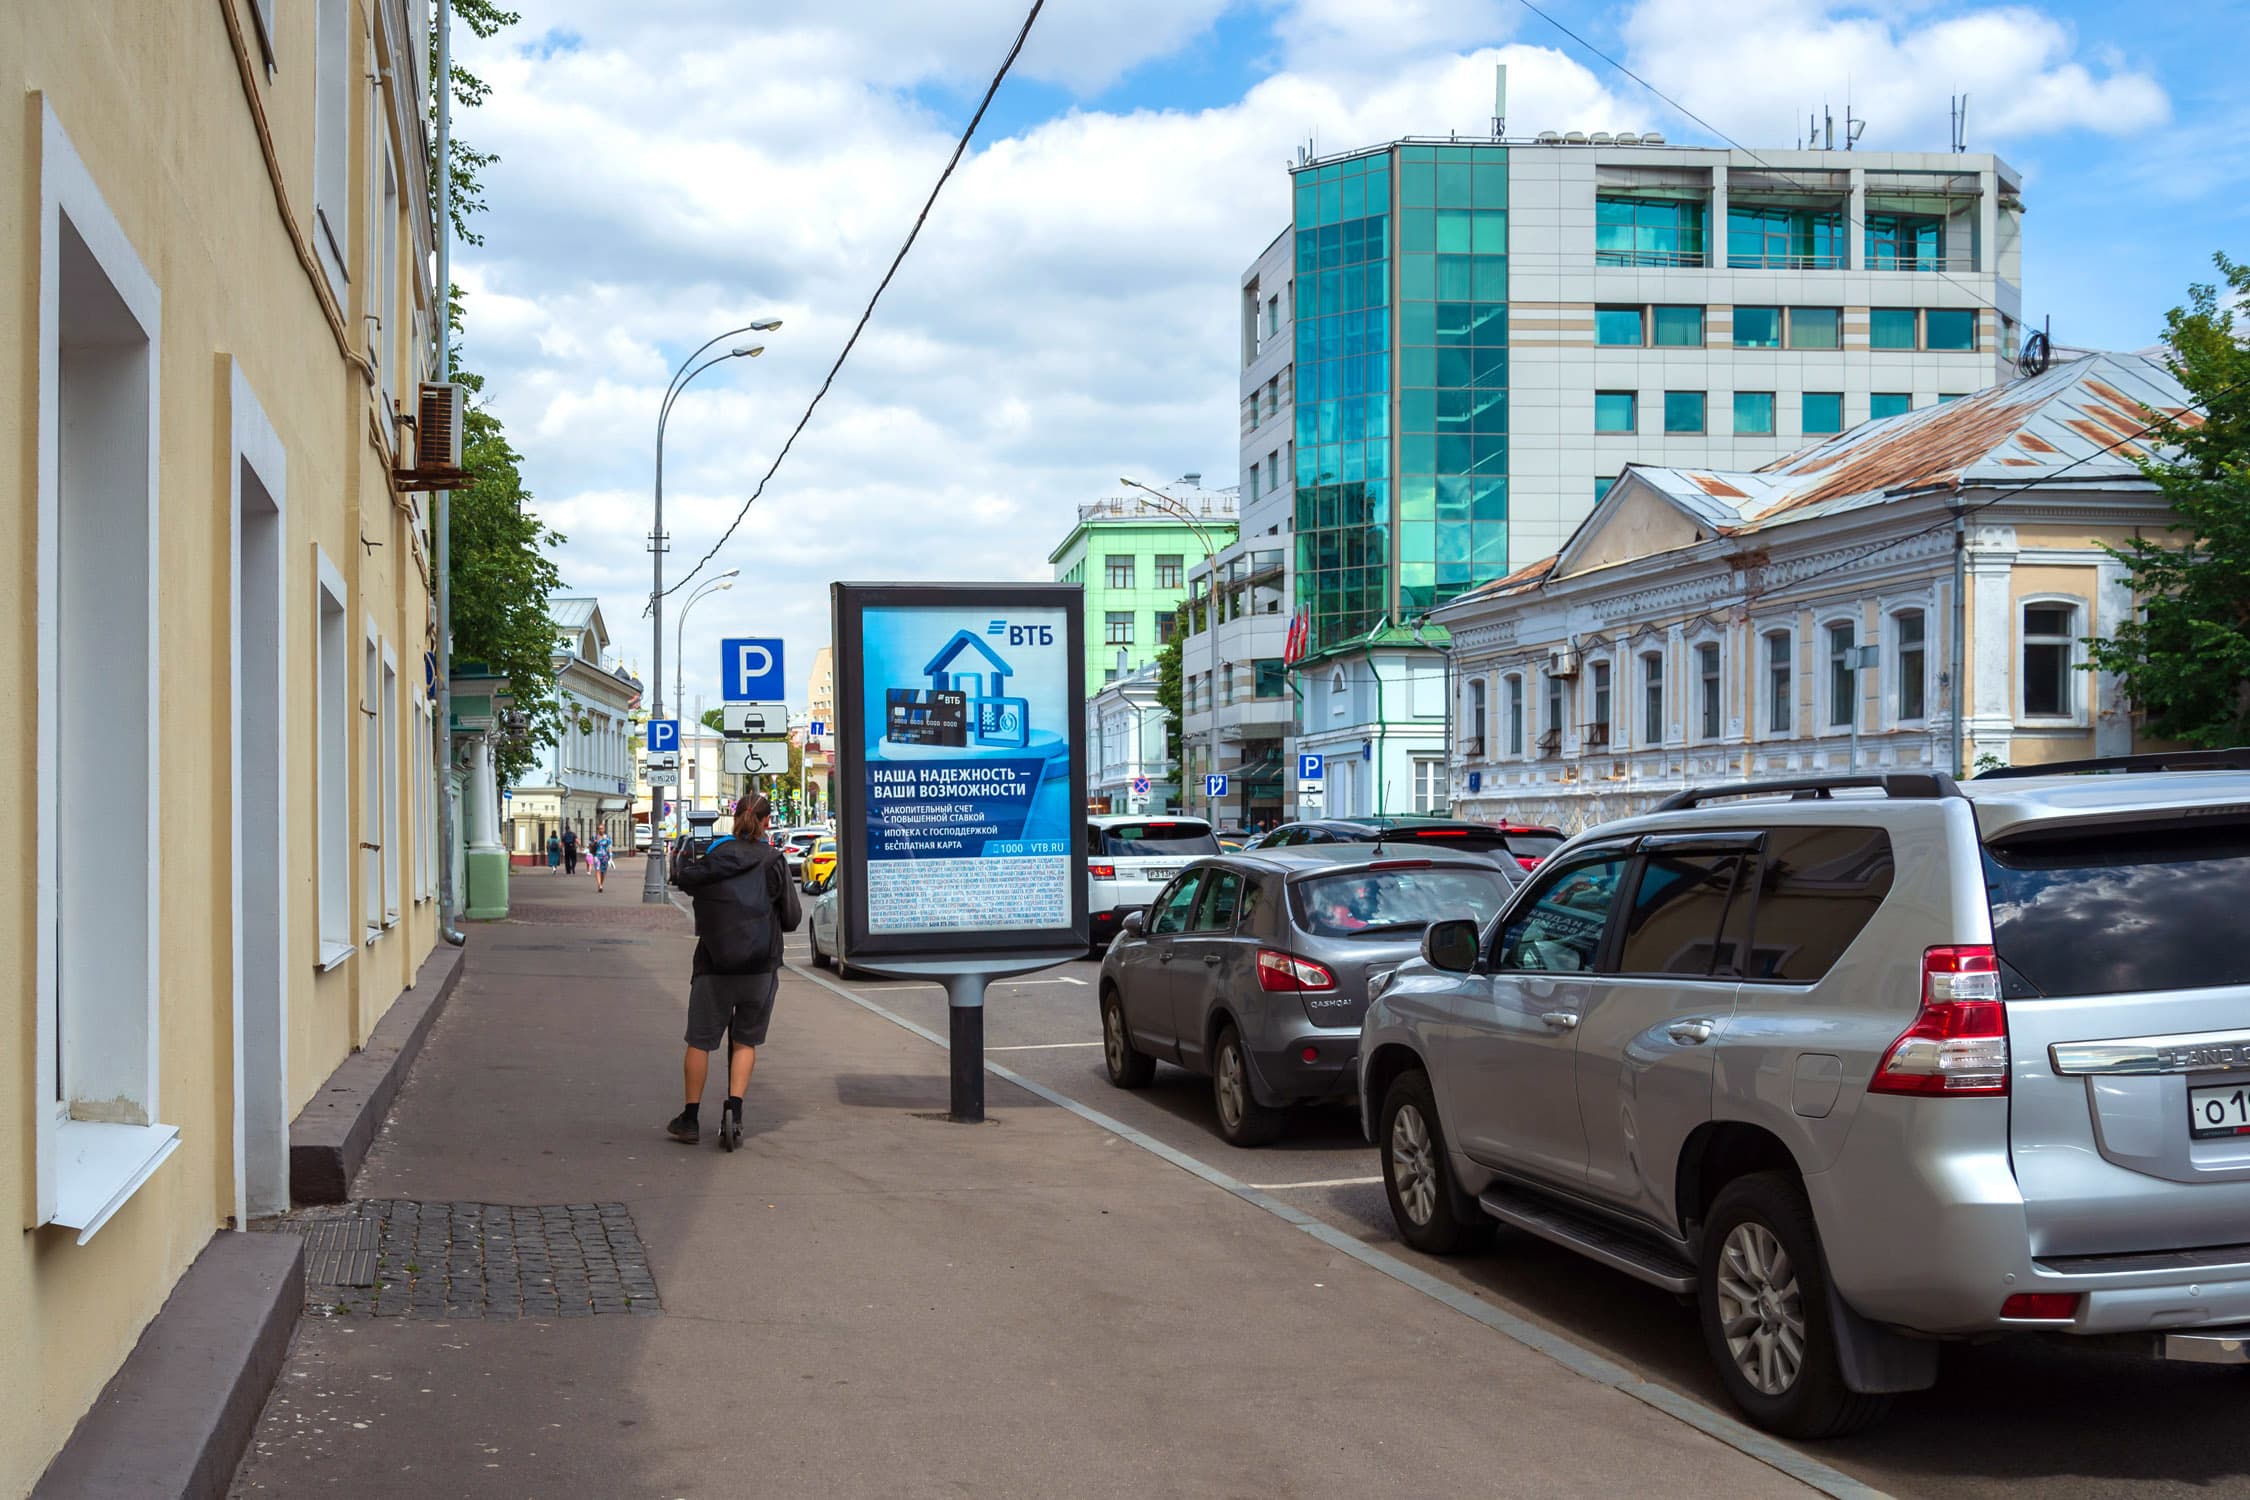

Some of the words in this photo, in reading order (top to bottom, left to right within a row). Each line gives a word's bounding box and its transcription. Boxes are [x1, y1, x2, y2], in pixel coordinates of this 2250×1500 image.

[1010, 625, 1053, 646] ВТБ
[739, 645, 773, 695] P
[945, 696, 960, 704] ВТБ
[656, 723, 673, 748] P
[1305, 757, 1319, 776] P
[874, 769, 916, 782] НАША
[920, 768, 1015, 784] НАДЕЖНОСТЬ
[874, 785, 915, 798] ВАШИ
[920, 783, 1025, 798] ВОЗМОЖНОСТИ
[884, 804, 952, 814] НАКОПИТЕЛЬНЫЙ
[954, 805, 973, 813] СЧЕТ
[884, 815, 889, 823] С
[891, 813, 947, 823] ПОВЫШЕННОЙ
[949, 812, 985, 822] СТАВКОЙ
[885, 828, 920, 837] ИПОТЕКА
[922, 828, 928, 836] С
[930, 825, 998, 836] ГОСПОДДЕРЖКОЙ
[885, 841, 935, 850] БЕСПЛАТНАЯ
[937, 840, 962, 849] КАРТА
[1001, 843, 1023, 853] 1000
[1031, 842, 1064, 852] VTB.RU
[2170, 1047, 2233, 1067] LAND
[2206, 1090, 2250, 1124] О1
